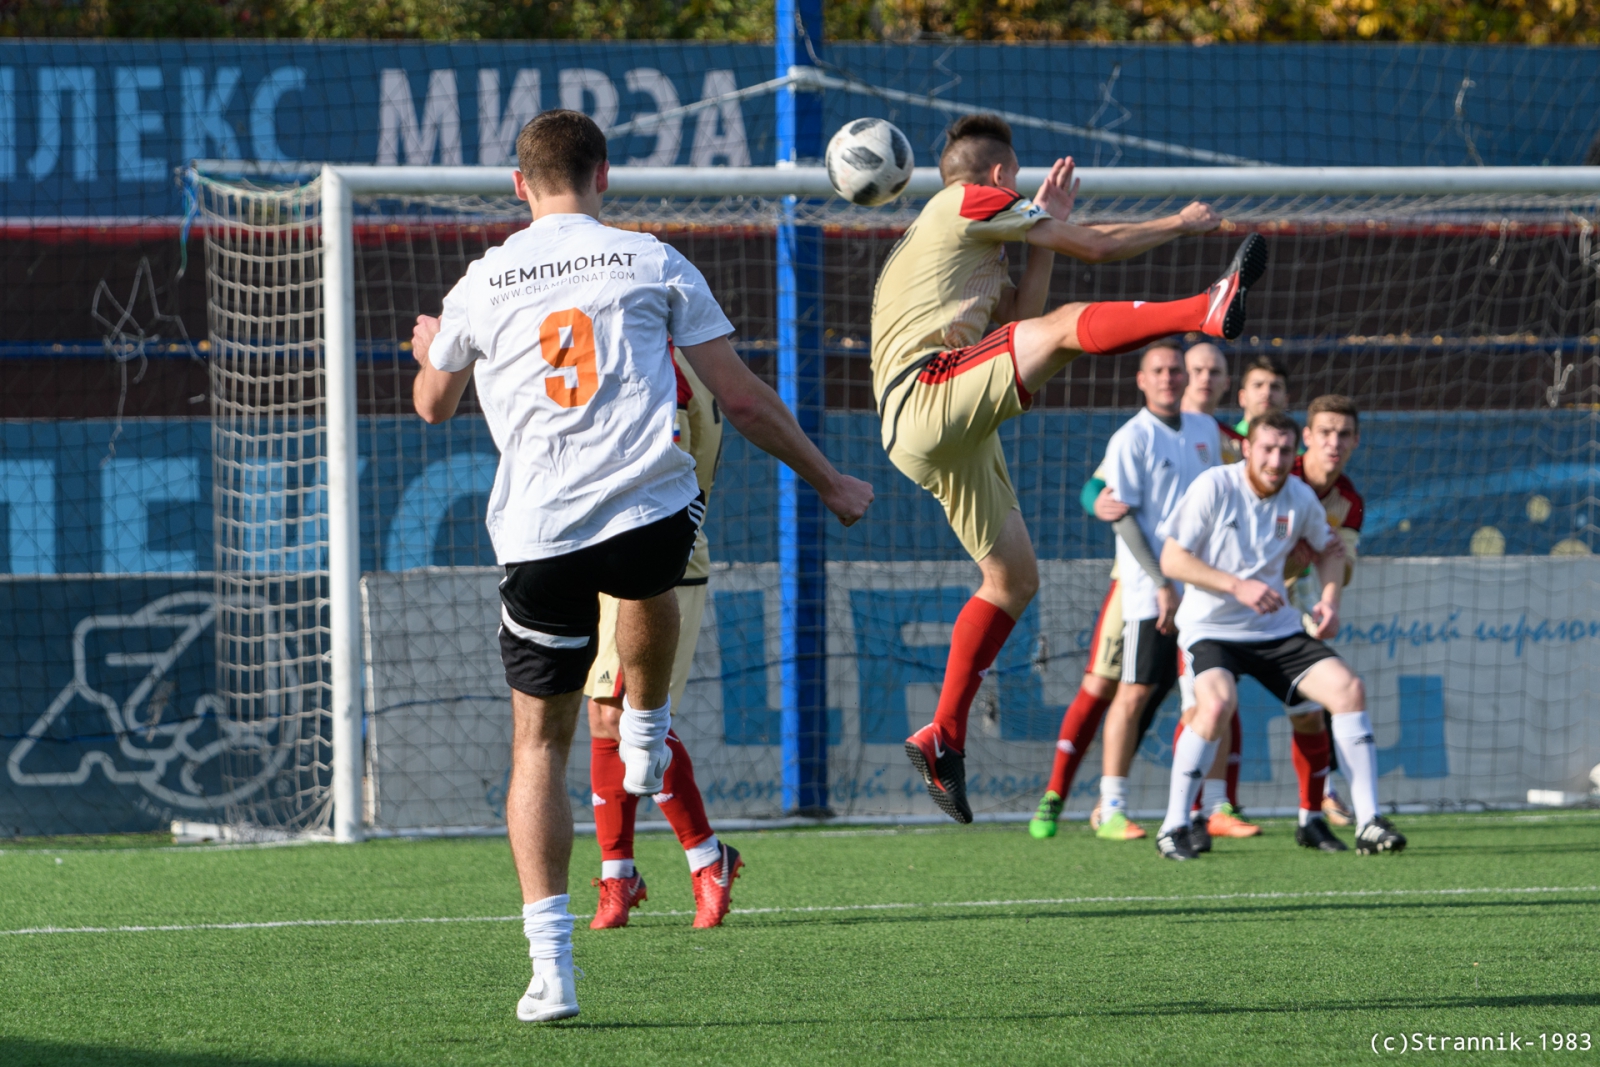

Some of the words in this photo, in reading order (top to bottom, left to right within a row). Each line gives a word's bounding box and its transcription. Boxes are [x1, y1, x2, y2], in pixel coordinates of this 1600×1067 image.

[0, 66, 306, 182] ЛЕКС
[376, 67, 752, 166] МИРЭА
[489, 252, 637, 289] ЧЕМПИОНАТ
[489, 270, 636, 306] WWW.CHAMPIONAT.COM
[539, 306, 599, 409] 9
